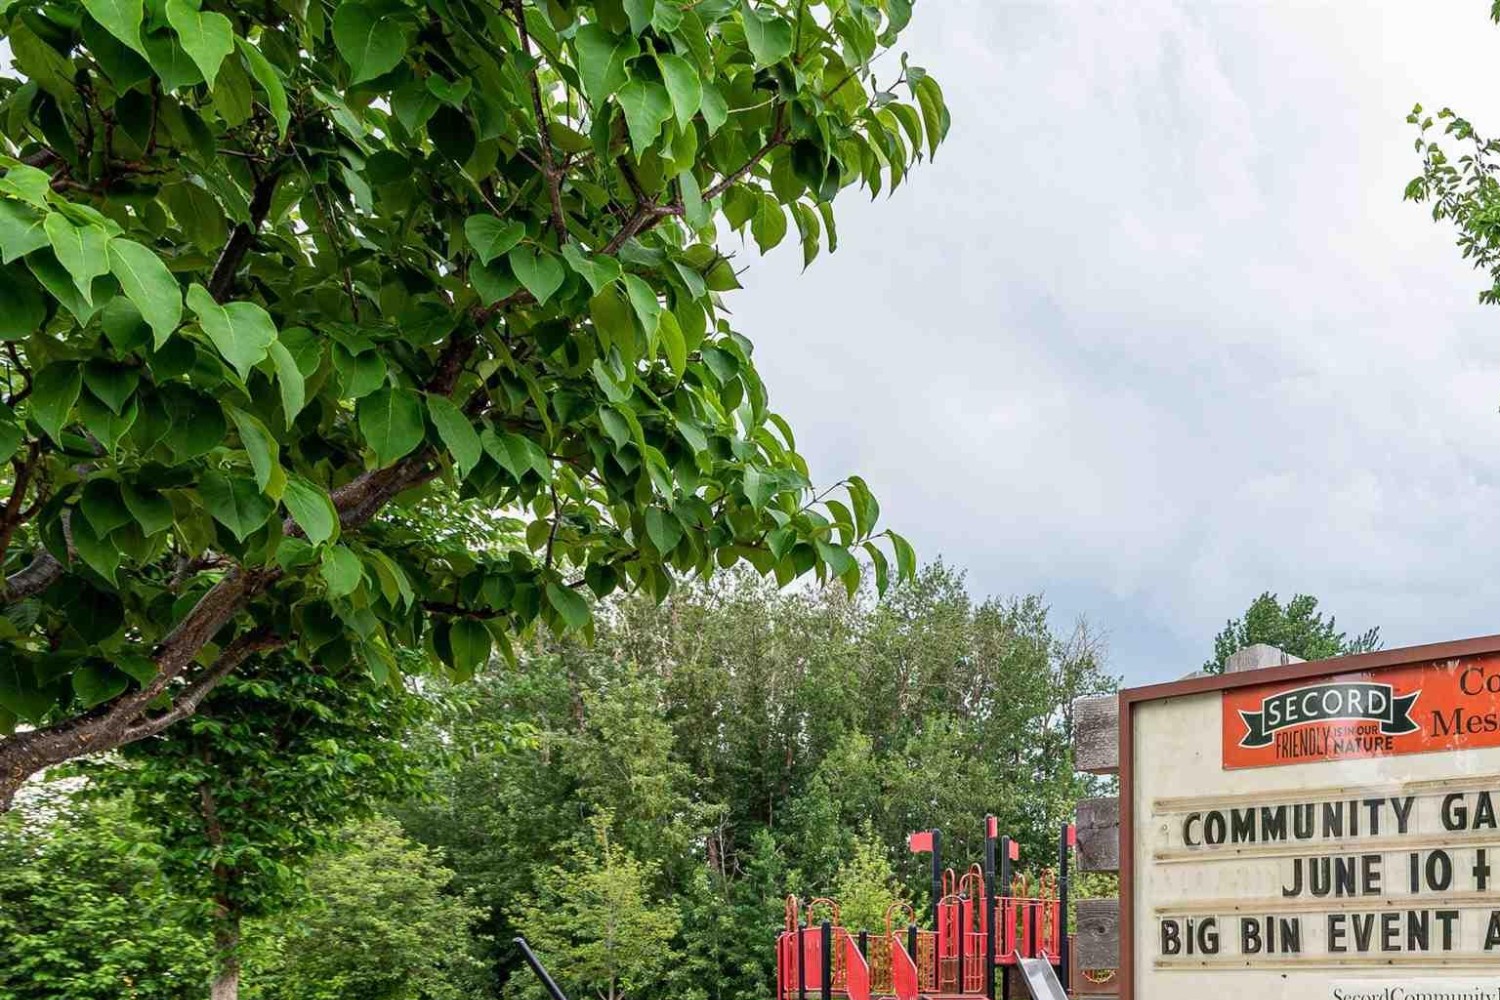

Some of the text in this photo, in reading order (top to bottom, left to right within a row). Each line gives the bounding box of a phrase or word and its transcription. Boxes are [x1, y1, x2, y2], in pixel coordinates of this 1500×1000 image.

[1268, 690, 1387, 726] SECORD
[1276, 726, 1331, 759] FRIENDLY
[1356, 725, 1379, 735] OUR
[1333, 736, 1393, 755] NATURE
[1182, 796, 1416, 847] COMMUNITY
[1282, 854, 1383, 898] JUNE
[1410, 850, 1452, 893] 10
[1160, 916, 1220, 956] BIG
[1241, 916, 1301, 954] BIN
[1328, 910, 1459, 952] EVENT
